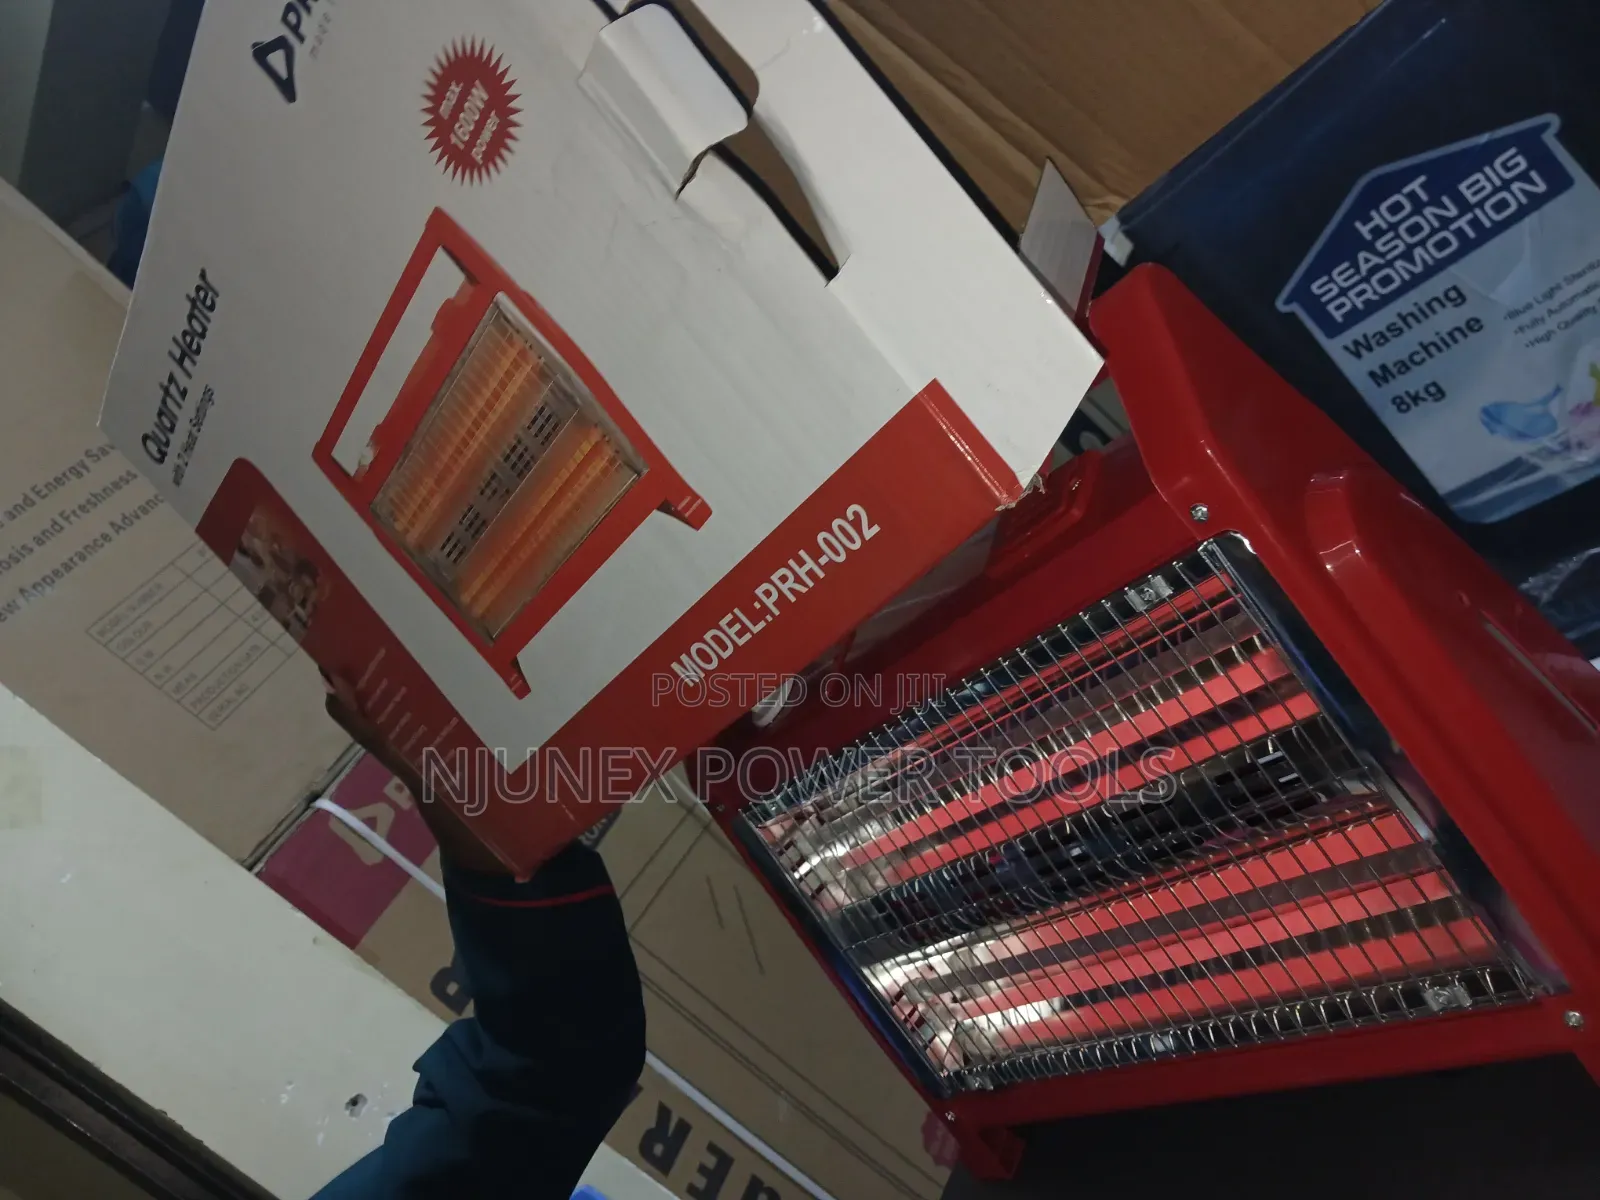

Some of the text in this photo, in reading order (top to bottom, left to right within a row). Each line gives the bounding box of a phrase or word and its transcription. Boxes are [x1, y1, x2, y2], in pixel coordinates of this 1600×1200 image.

[449, 79, 489, 150] 1600W
[471, 109, 500, 165] power
[1310, 146, 1528, 302] SEASON BIG
[1354, 174, 1428, 241] HOT
[1326, 170, 1548, 323] PROMOTION
[1342, 284, 1467, 361] Washing
[1367, 315, 1485, 388] Machine
[141, 267, 220, 465] Quartz Heater
[1391, 380, 1446, 414] 8kg
[0, 469, 138, 574] osis and Freshness
[3, 492, 37, 522] and
[30, 458, 91, 500] Energy
[19, 532, 112, 605] Appearance
[670, 503, 880, 688] MODEL:PRH-002
